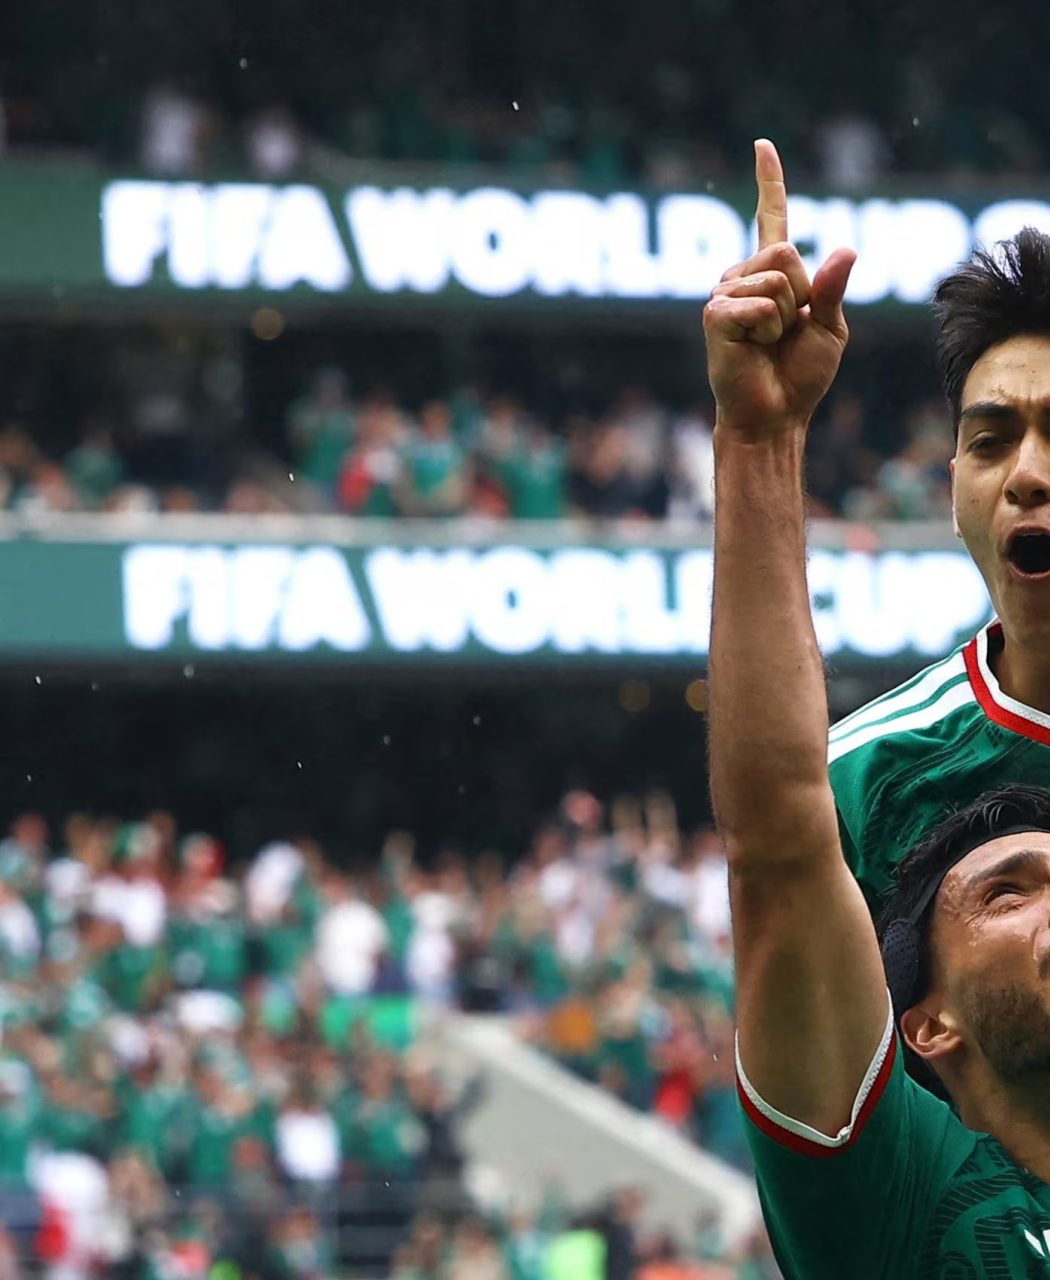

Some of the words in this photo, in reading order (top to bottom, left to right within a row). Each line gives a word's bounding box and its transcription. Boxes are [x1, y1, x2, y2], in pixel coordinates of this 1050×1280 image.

[102, 180, 352, 291] FIFA
[345, 185, 750, 301] WORLD
[748, 194, 974, 304] CUP
[122, 544, 371, 651] FIFA
[804, 550, 994, 657] CUP
